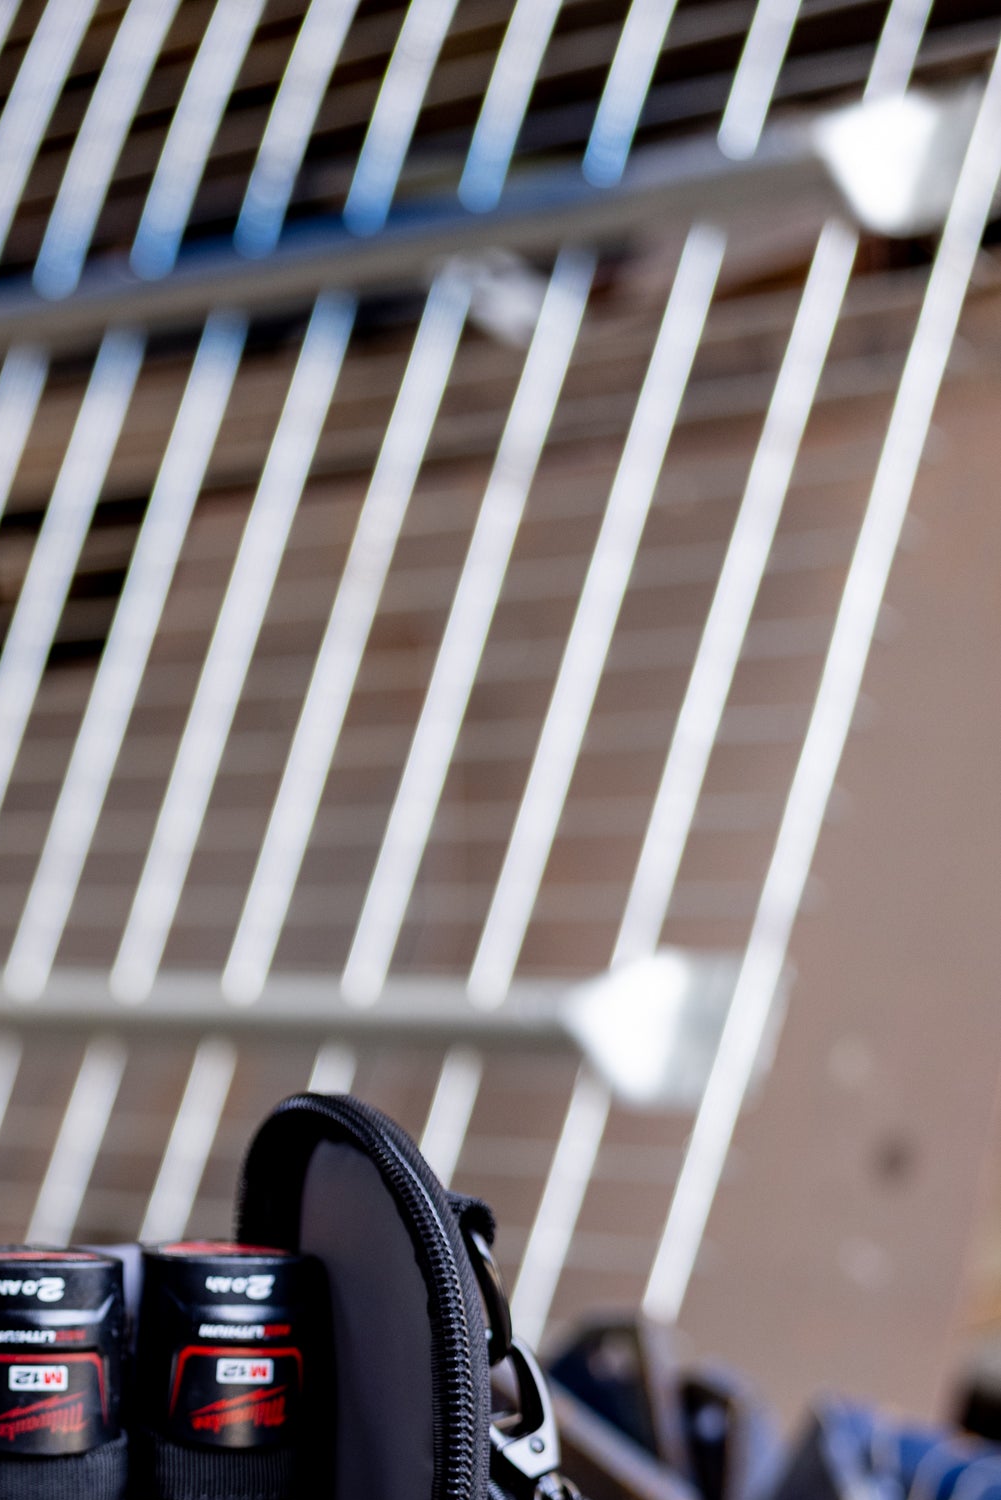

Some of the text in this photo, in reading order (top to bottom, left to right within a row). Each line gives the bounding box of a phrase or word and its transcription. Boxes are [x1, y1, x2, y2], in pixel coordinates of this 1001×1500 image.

[206, 1275, 275, 1300] 2.0Ah
[13, 1369, 64, 1386] M12
[222, 1362, 269, 1379] M12
